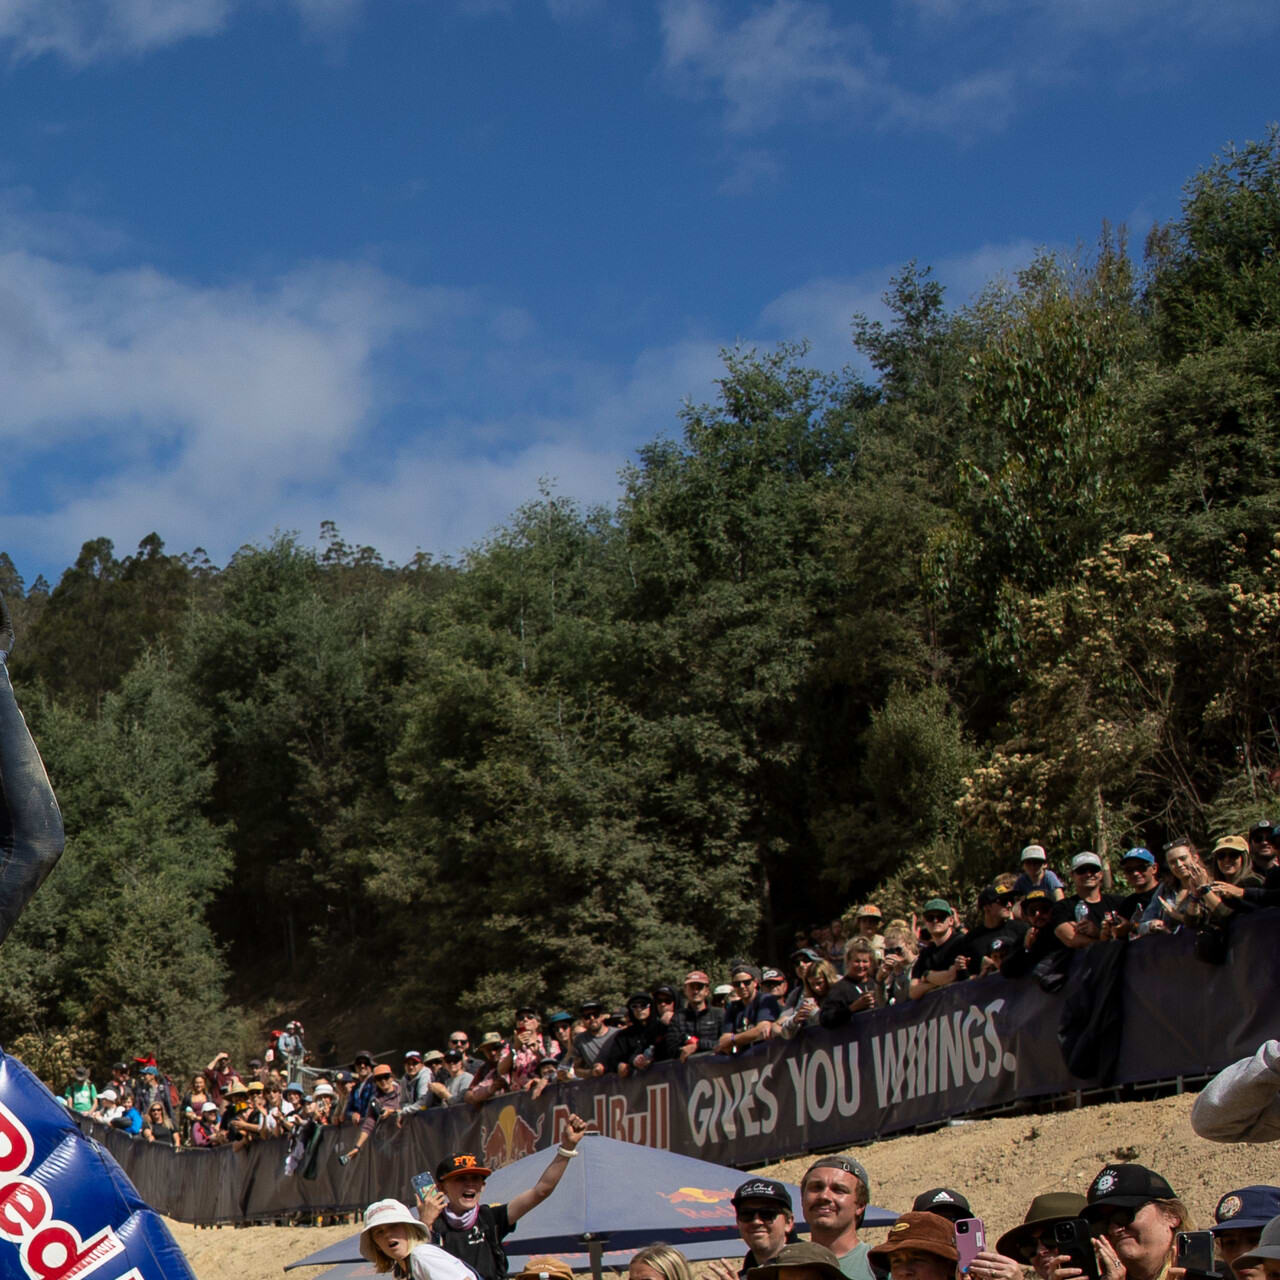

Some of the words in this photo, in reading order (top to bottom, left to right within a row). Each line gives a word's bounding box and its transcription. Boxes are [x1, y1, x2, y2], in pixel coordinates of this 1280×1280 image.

[551, 1094, 607, 1145] Rd
[688, 1063, 777, 1147] GIVES
[787, 1042, 860, 1126] YOU
[453, 1155, 478, 1168] FOX
